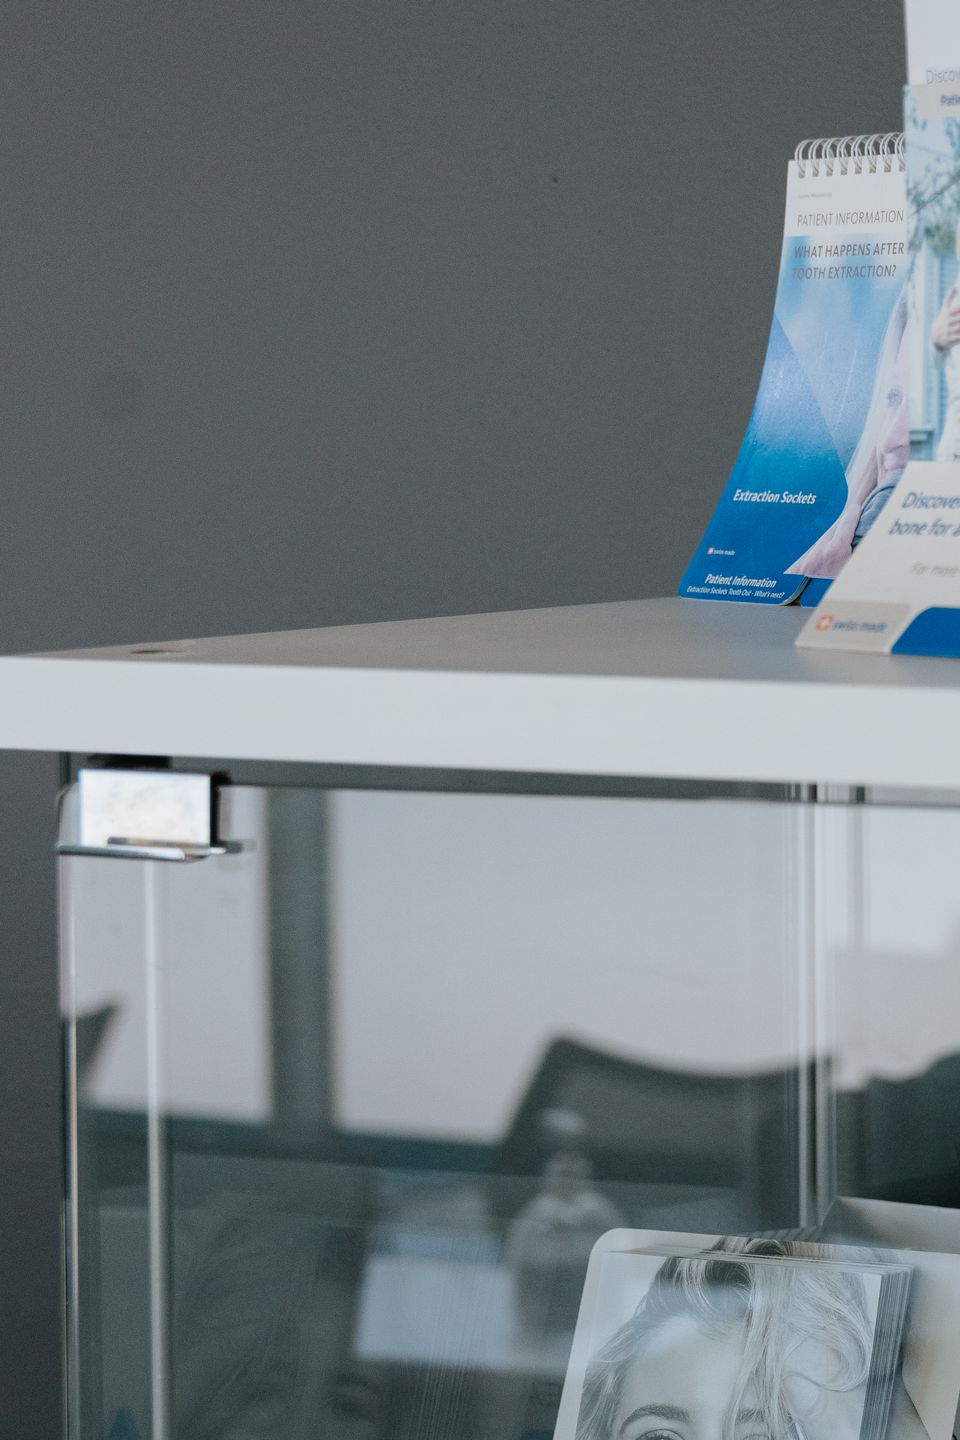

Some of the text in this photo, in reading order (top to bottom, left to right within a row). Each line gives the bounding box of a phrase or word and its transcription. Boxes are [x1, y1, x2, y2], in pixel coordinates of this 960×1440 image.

[797, 210, 904, 227] PATIENT INFORMATION
[794, 242, 904, 259] WHAT HAPPENS AFTER
[792, 264, 896, 281] TOOTH EXTRACTION?
[733, 489, 817, 505] Extraction Sockets
[889, 518, 927, 536] bone
[930, 518, 951, 540] for
[705, 574, 777, 588] Patient Information
[687, 586, 711, 594] Extraction
[711, 587, 728, 596] Sockets
[728, 588, 741, 596] Tooth
